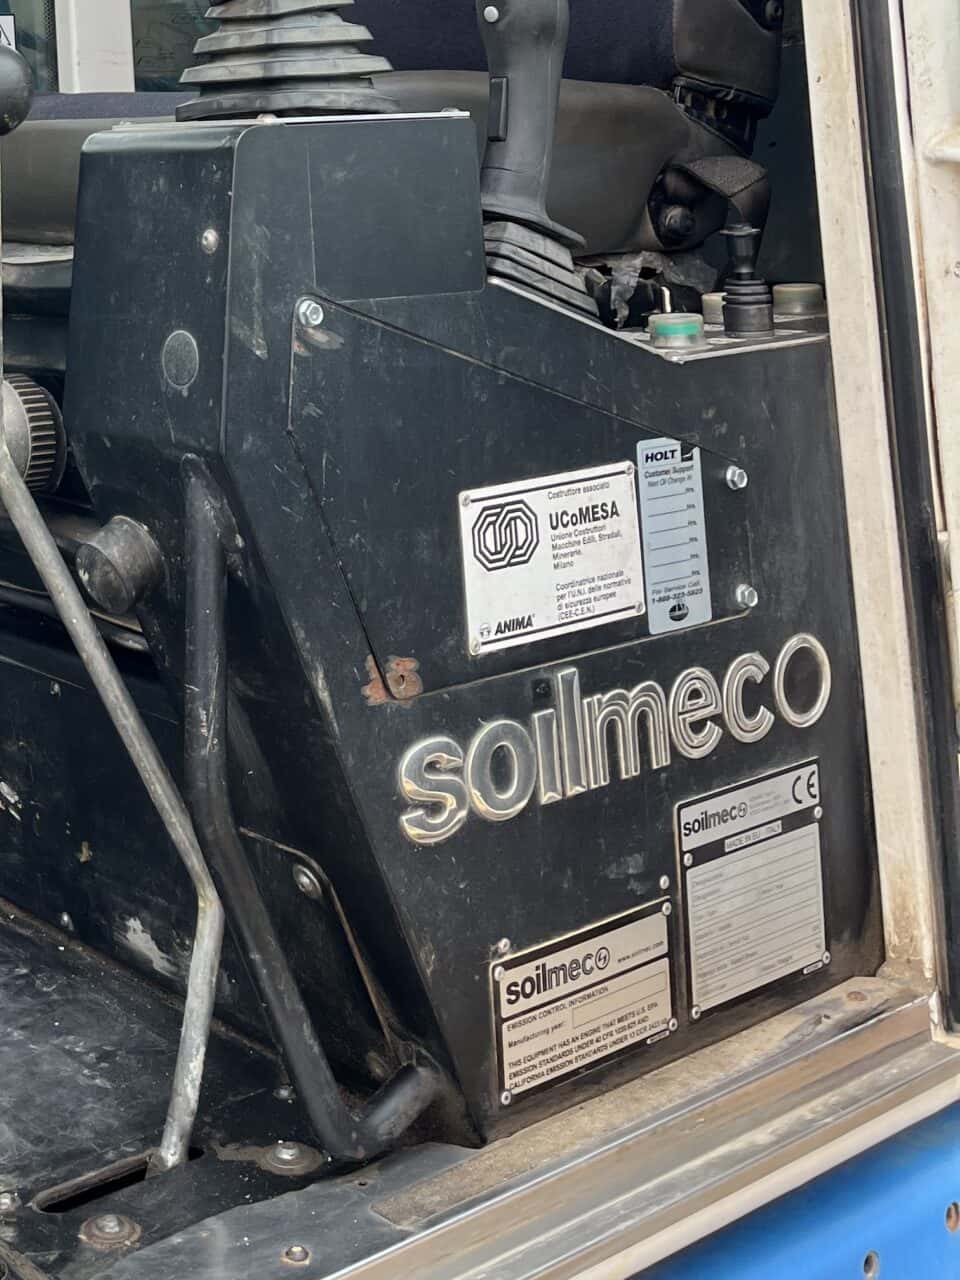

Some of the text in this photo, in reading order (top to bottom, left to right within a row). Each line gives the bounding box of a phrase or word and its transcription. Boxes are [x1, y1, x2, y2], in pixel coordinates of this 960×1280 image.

[645, 449, 678, 464] HOLT
[547, 481, 610, 501] Costruttore associato
[549, 500, 620, 531] UCoMESA
[551, 524, 607, 542] Unione Costruttori
[552, 539, 581, 551] Macchine
[553, 560, 575, 570] Milano
[494, 614, 533, 636] ANIMA
[507, 985, 609, 1032] EMISSION CONTROL INFORMATION
[508, 1028, 550, 1049] Manufacturing
[509, 1058, 522, 1070] THIS
[523, 1043, 557, 1062] EQUIPMENT
[558, 1038, 570, 1049] HAS
[571, 1035, 579, 1044] AN
[580, 1025, 601, 1040] ENGINE
[509, 1063, 538, 1080] EMISSION
[538, 1047, 575, 1068] STANDARDS
[574, 1036, 594, 1054] UNDER
[509, 1071, 546, 1090] CALIFORNIA
[546, 1058, 574, 1076] EMISSION
[574, 1043, 608, 1064] STANDARDS
[608, 1033, 628, 1048] UNDER
